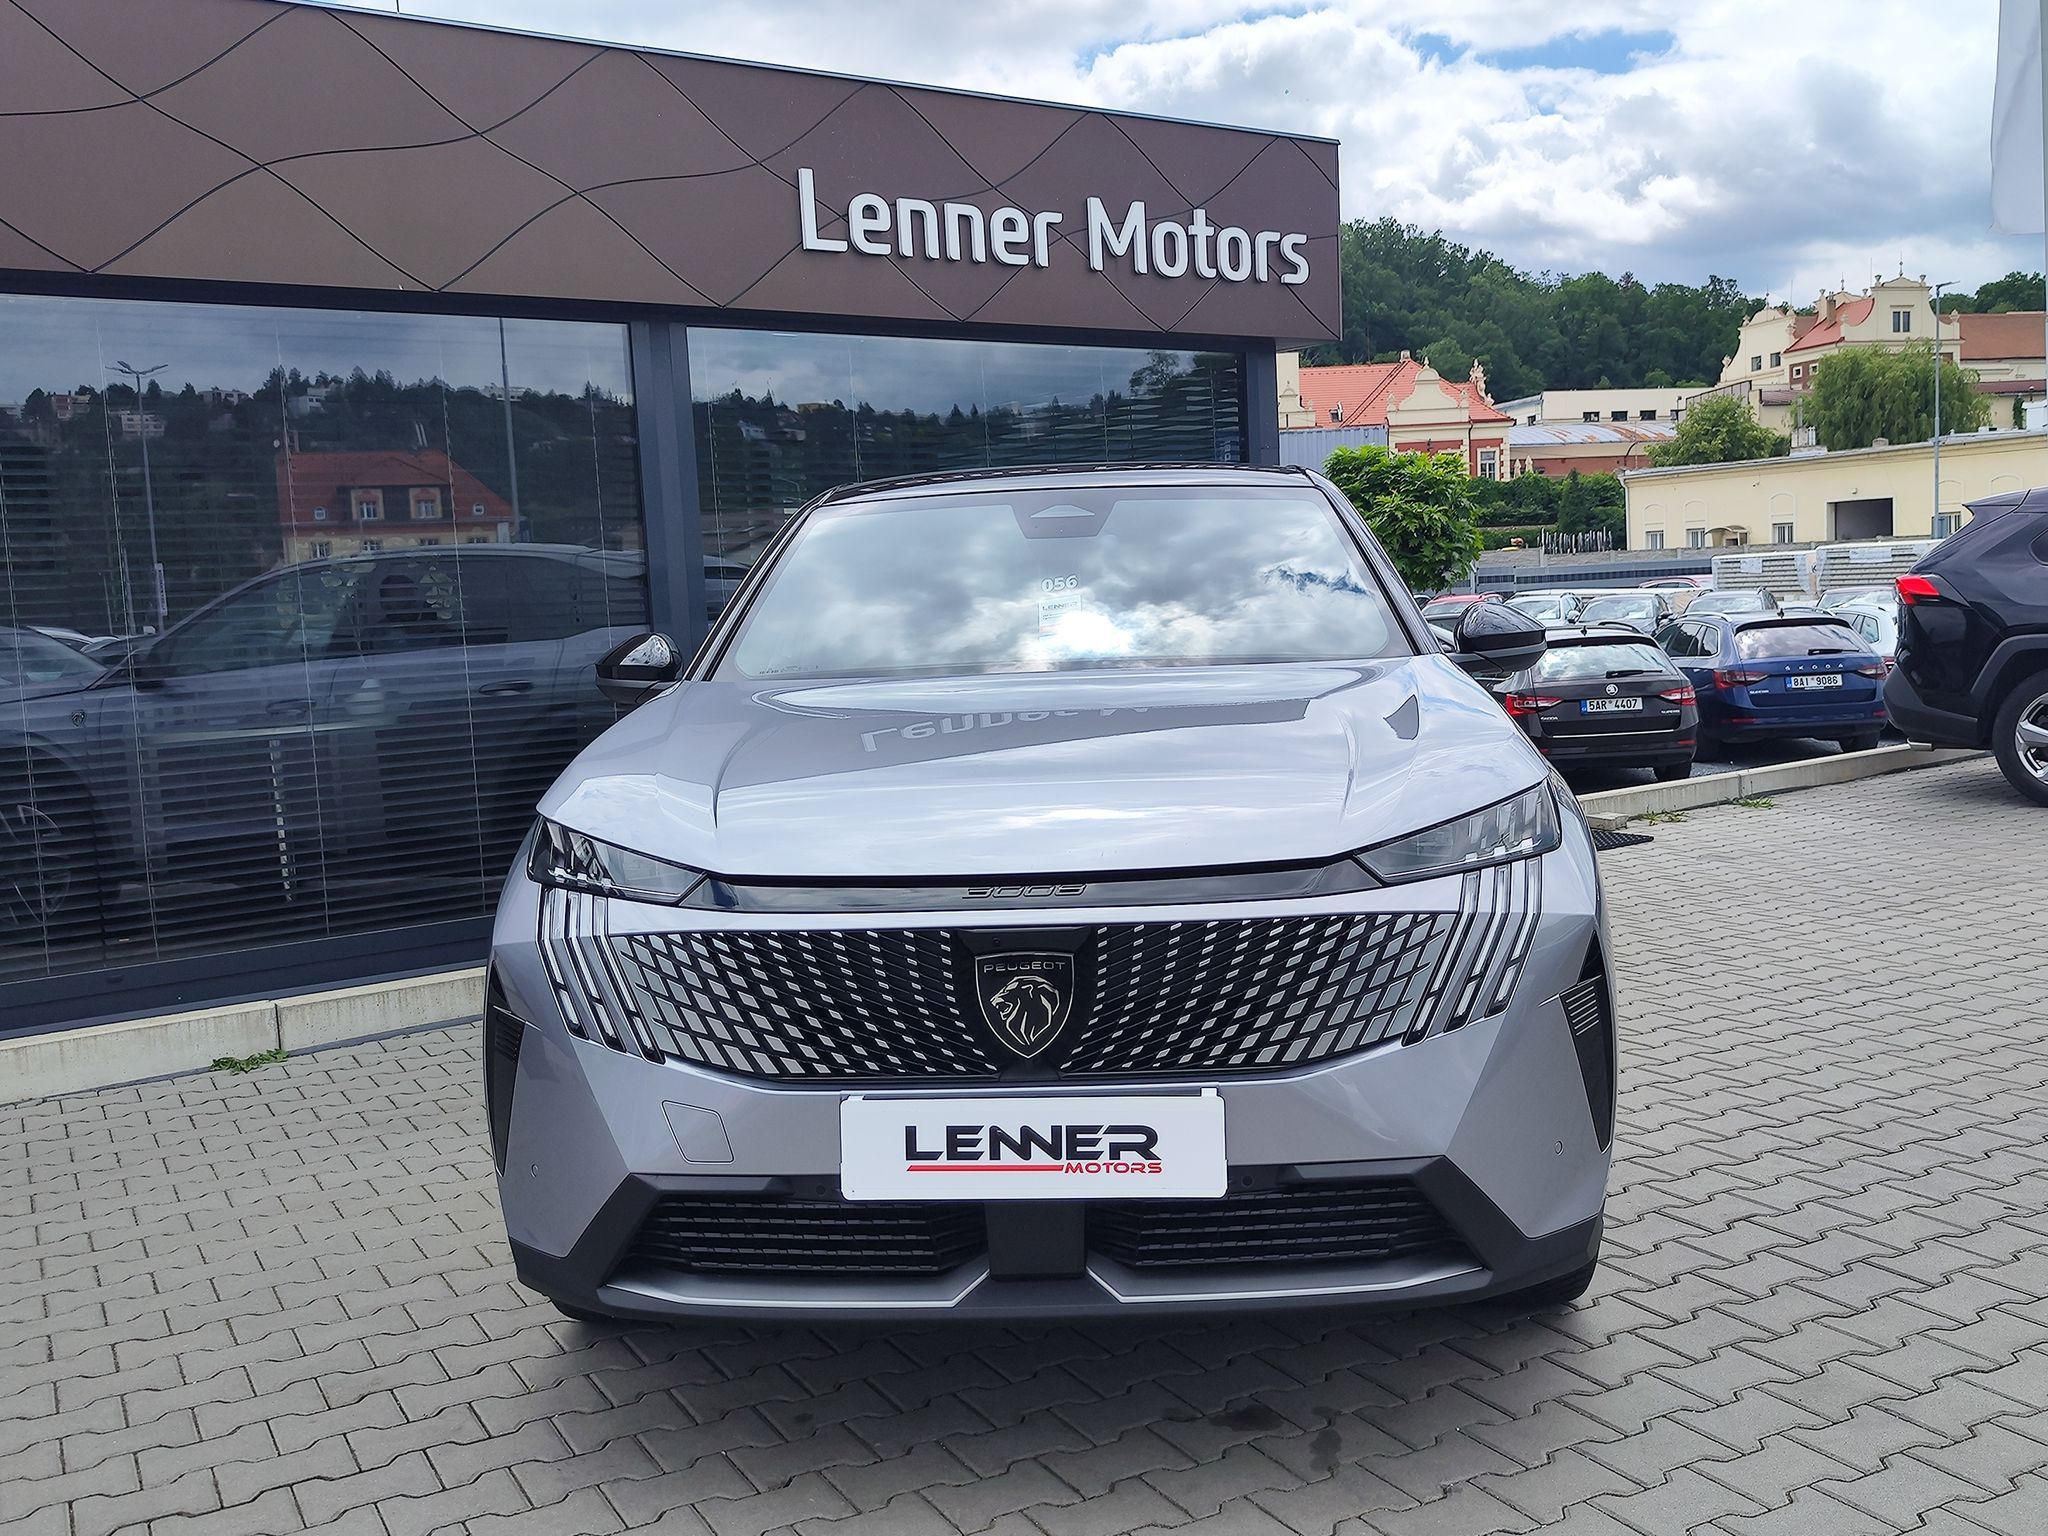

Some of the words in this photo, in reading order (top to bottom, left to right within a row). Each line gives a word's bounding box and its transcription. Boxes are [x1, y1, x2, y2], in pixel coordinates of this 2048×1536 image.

[796, 166, 1063, 268] Lenner
[1086, 196, 1310, 285] Motors
[1041, 574, 1079, 592] 056
[1816, 676, 1838, 686] 9086
[1588, 700, 1607, 711] 5AR
[1614, 698, 1638, 709] 4407
[983, 961, 1066, 973] PEUGEOT
[905, 1125, 1162, 1161] LENNER
[1064, 1162, 1163, 1174] MOTORS
